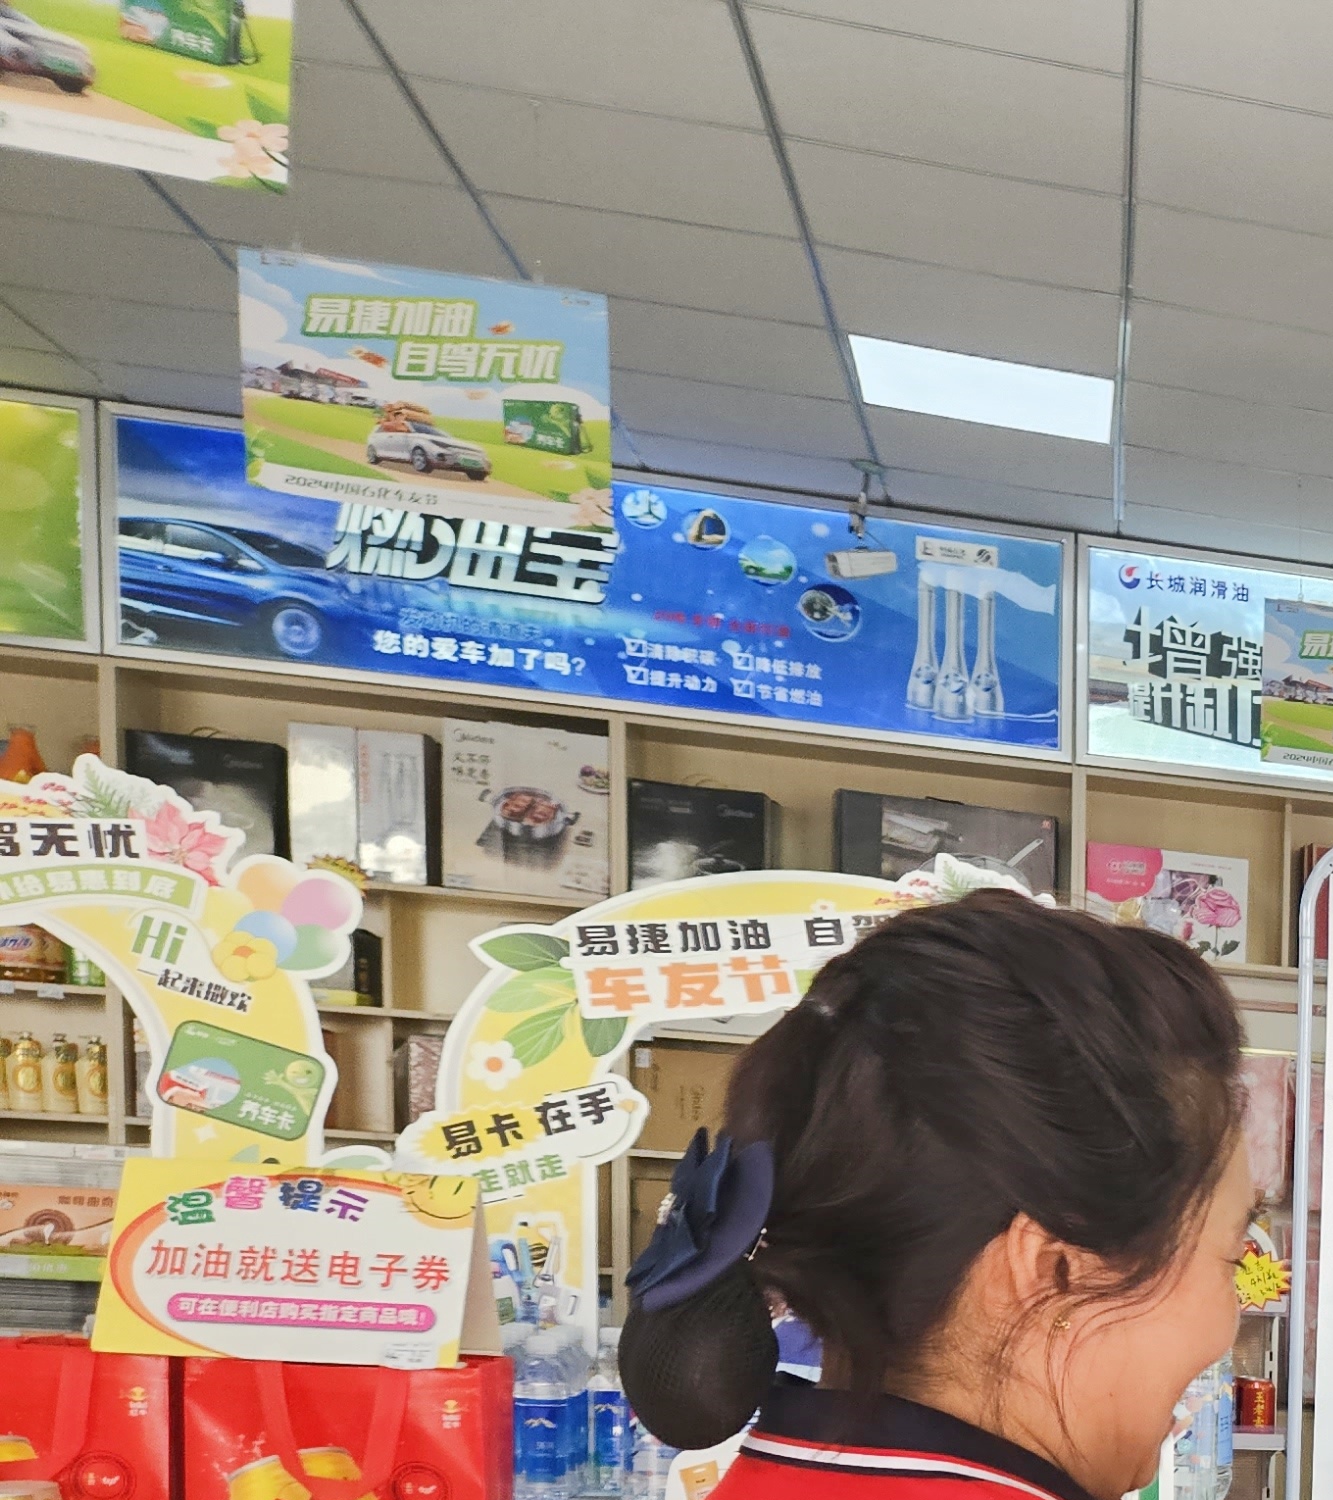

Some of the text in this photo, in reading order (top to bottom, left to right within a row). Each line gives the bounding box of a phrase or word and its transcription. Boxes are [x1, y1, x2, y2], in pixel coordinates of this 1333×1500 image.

[304, 298, 476, 337] 易捷加油
[396, 341, 561, 380] 自驾无忧
[1146, 570, 1250, 603] 长城润滑油
[372, 629, 587, 677] 您的爱车加了吗?
[131, 914, 188, 966] Hi
[574, 917, 773, 958] 易捷加油
[585, 953, 794, 1012] 车友节
[237, 1098, 296, 1134] 养车卡
[441, 1087, 615, 1160] 易卡在手
[166, 1175, 369, 1226] 温馨提示
[145, 1239, 450, 1291] 加油就送电子券
